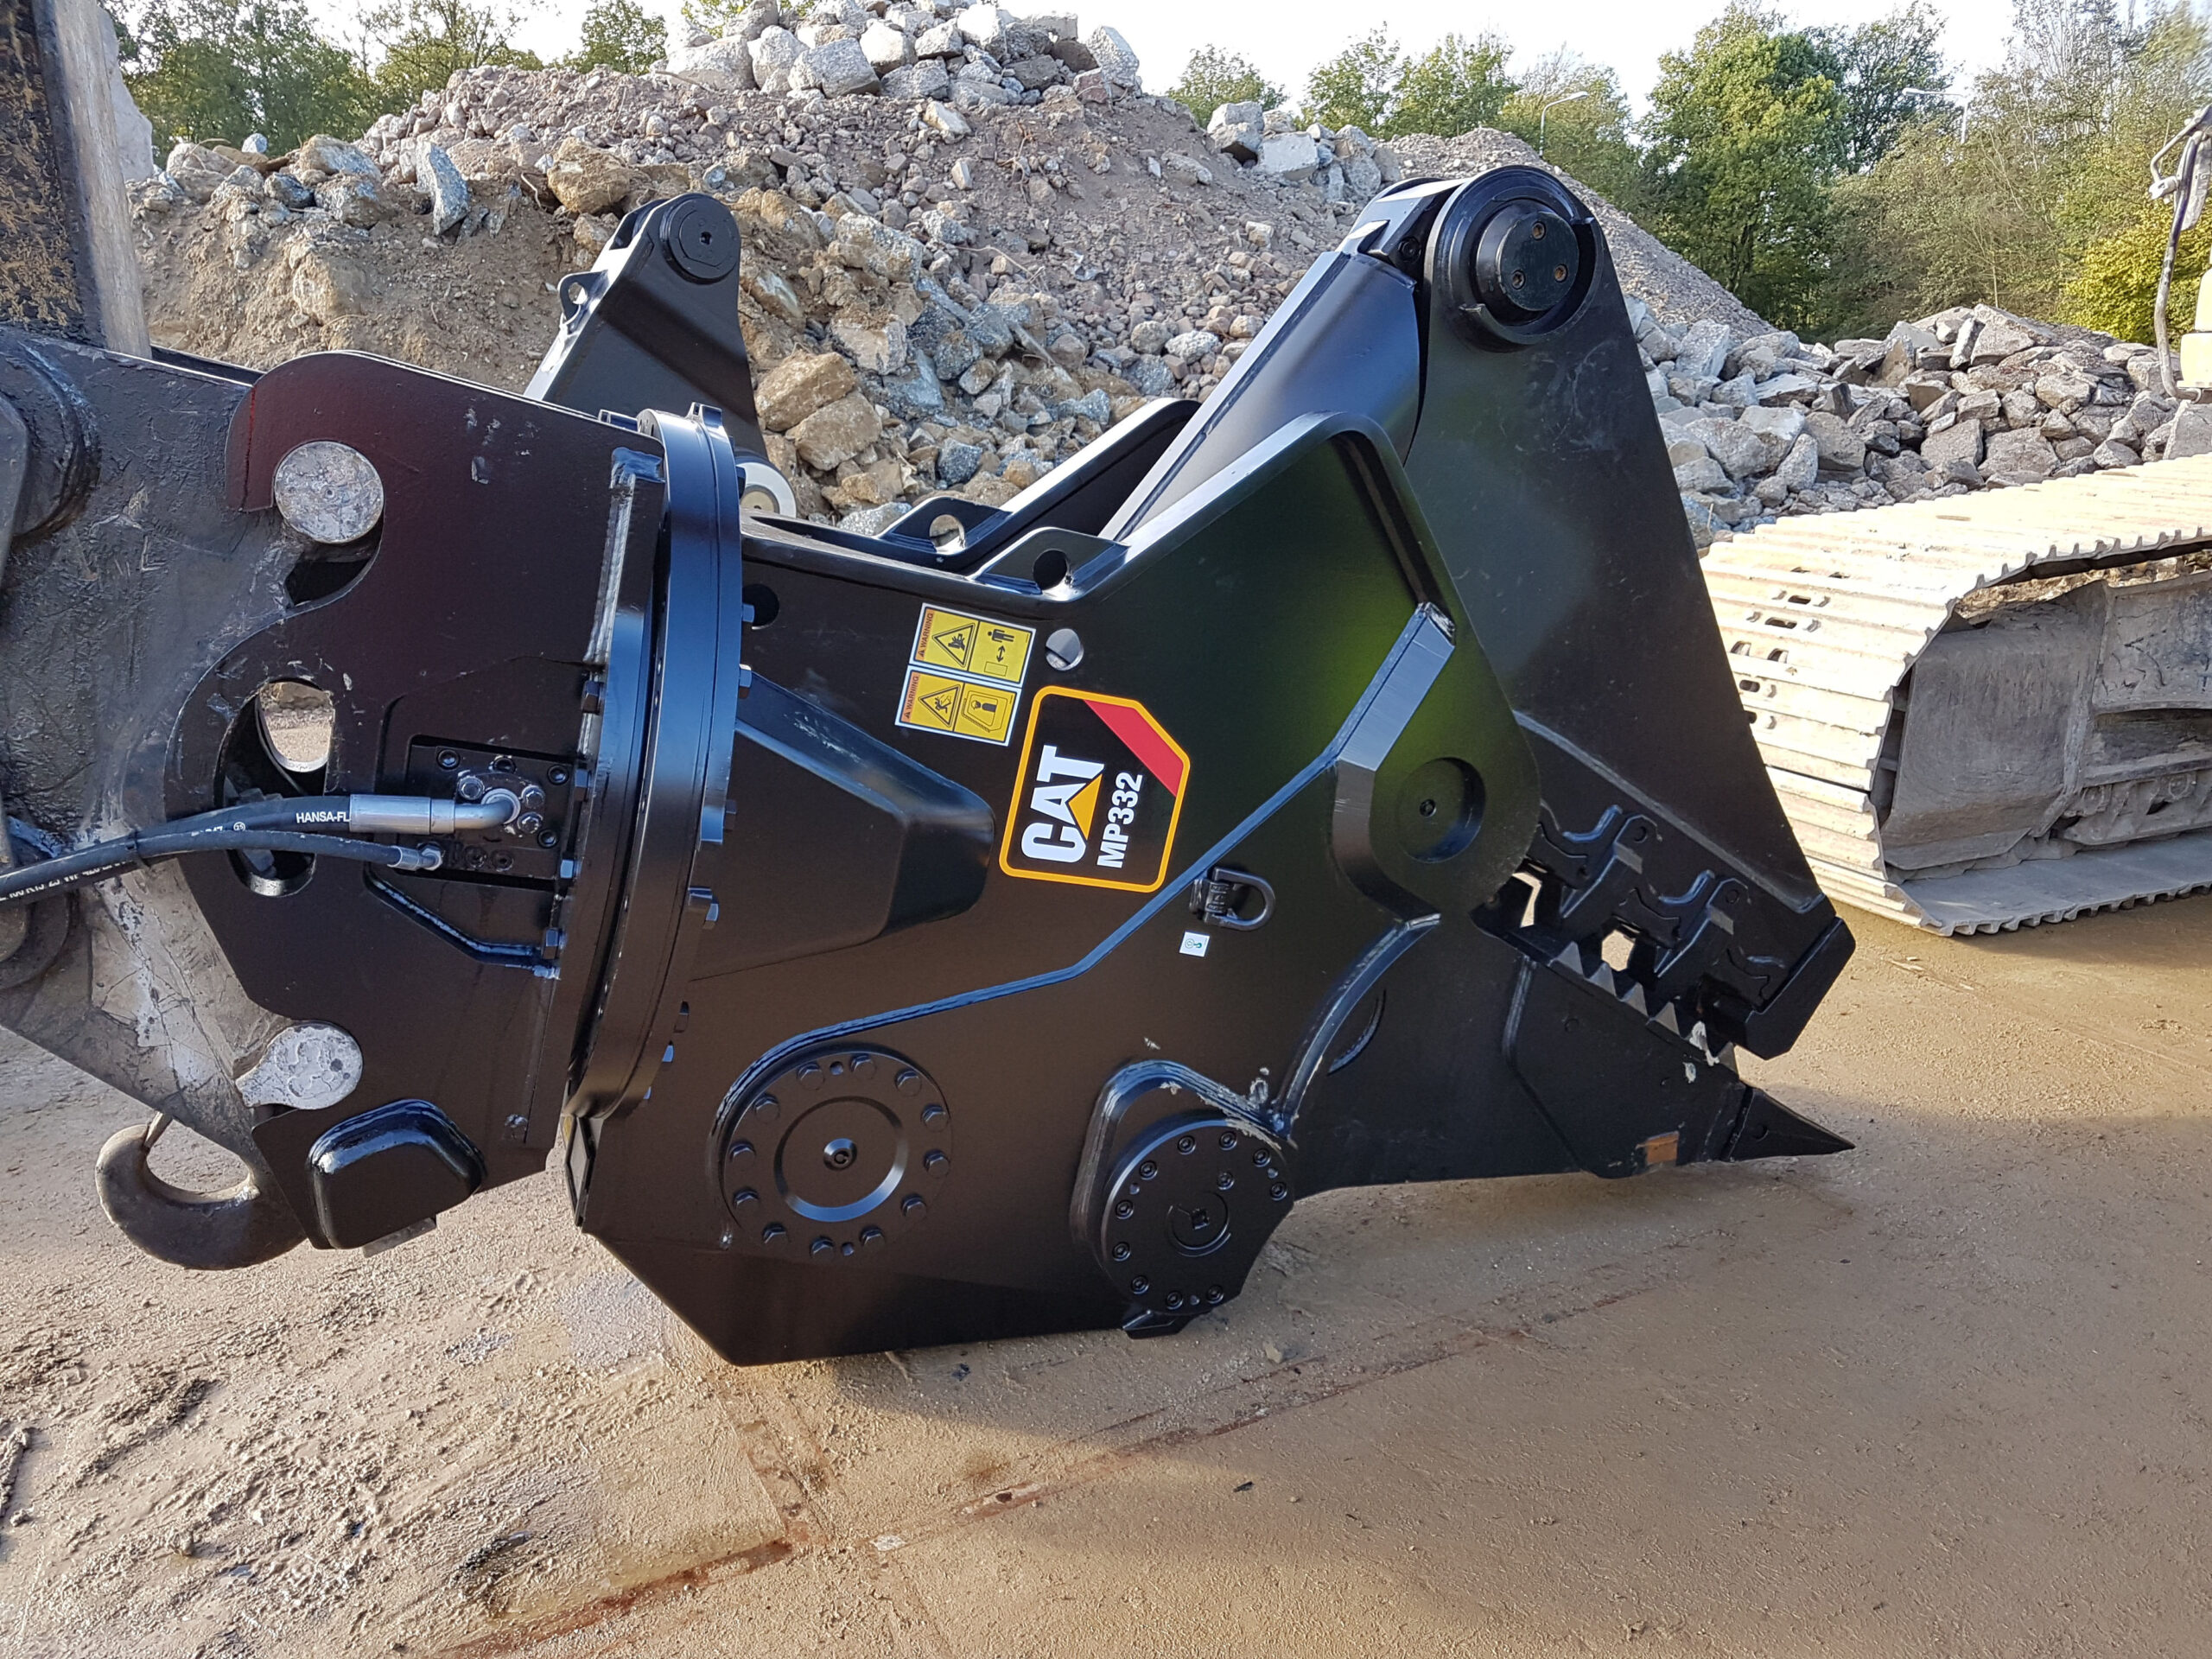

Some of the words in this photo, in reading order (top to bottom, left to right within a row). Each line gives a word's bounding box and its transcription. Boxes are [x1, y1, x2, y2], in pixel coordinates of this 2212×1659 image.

[920, 613, 934, 649] WARNING
[906, 676, 919, 711] WARNING
[1021, 744, 1105, 863] CAT
[1096, 772, 1143, 868] MP332
